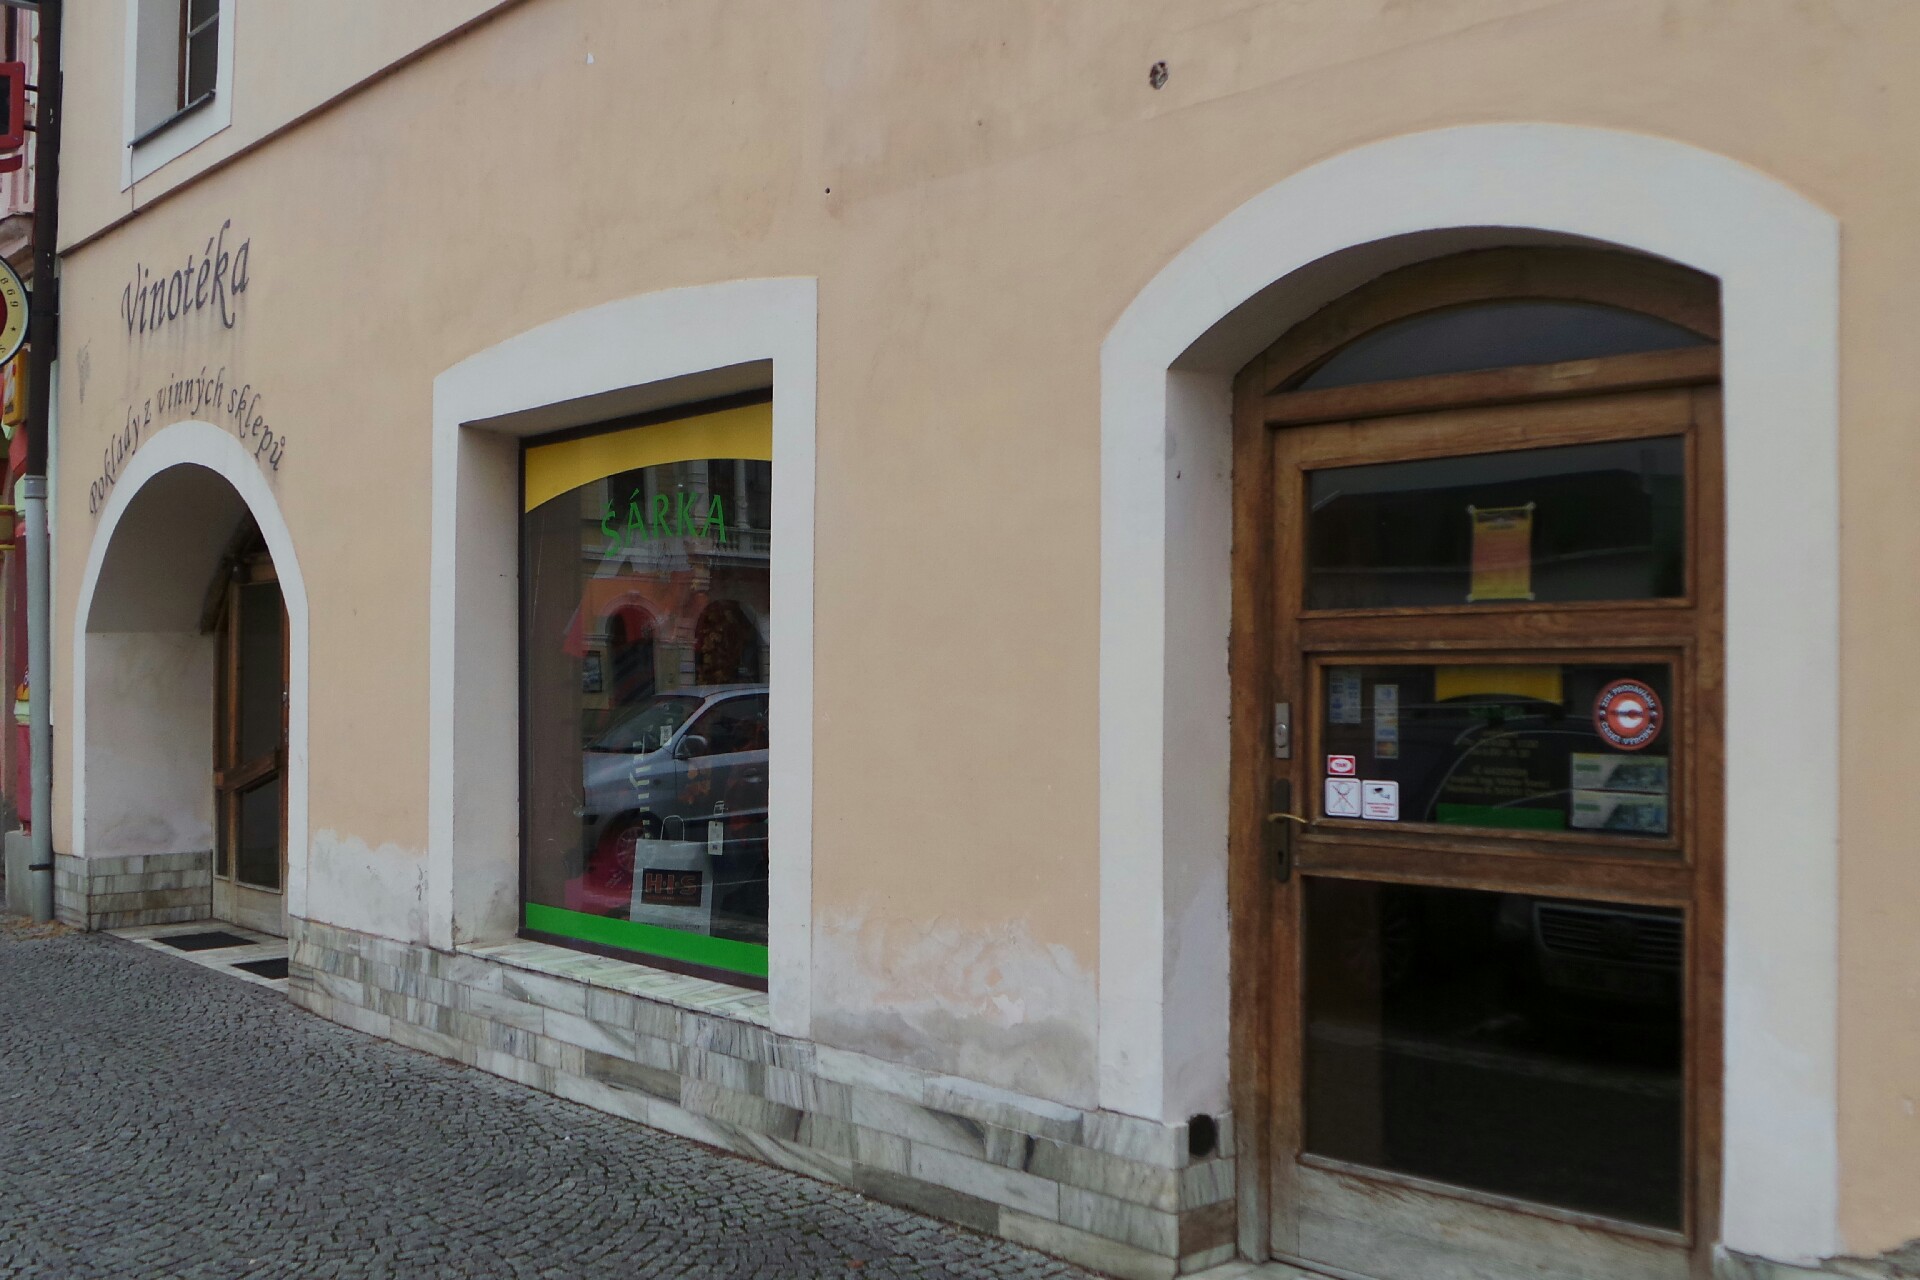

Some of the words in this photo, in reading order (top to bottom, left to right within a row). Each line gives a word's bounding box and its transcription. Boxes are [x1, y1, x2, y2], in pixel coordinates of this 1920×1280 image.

[121, 218, 250, 336] Vinotéka
[143, 398, 152, 428] z
[157, 366, 226, 416] vinných
[228, 384, 286, 471] sklepů
